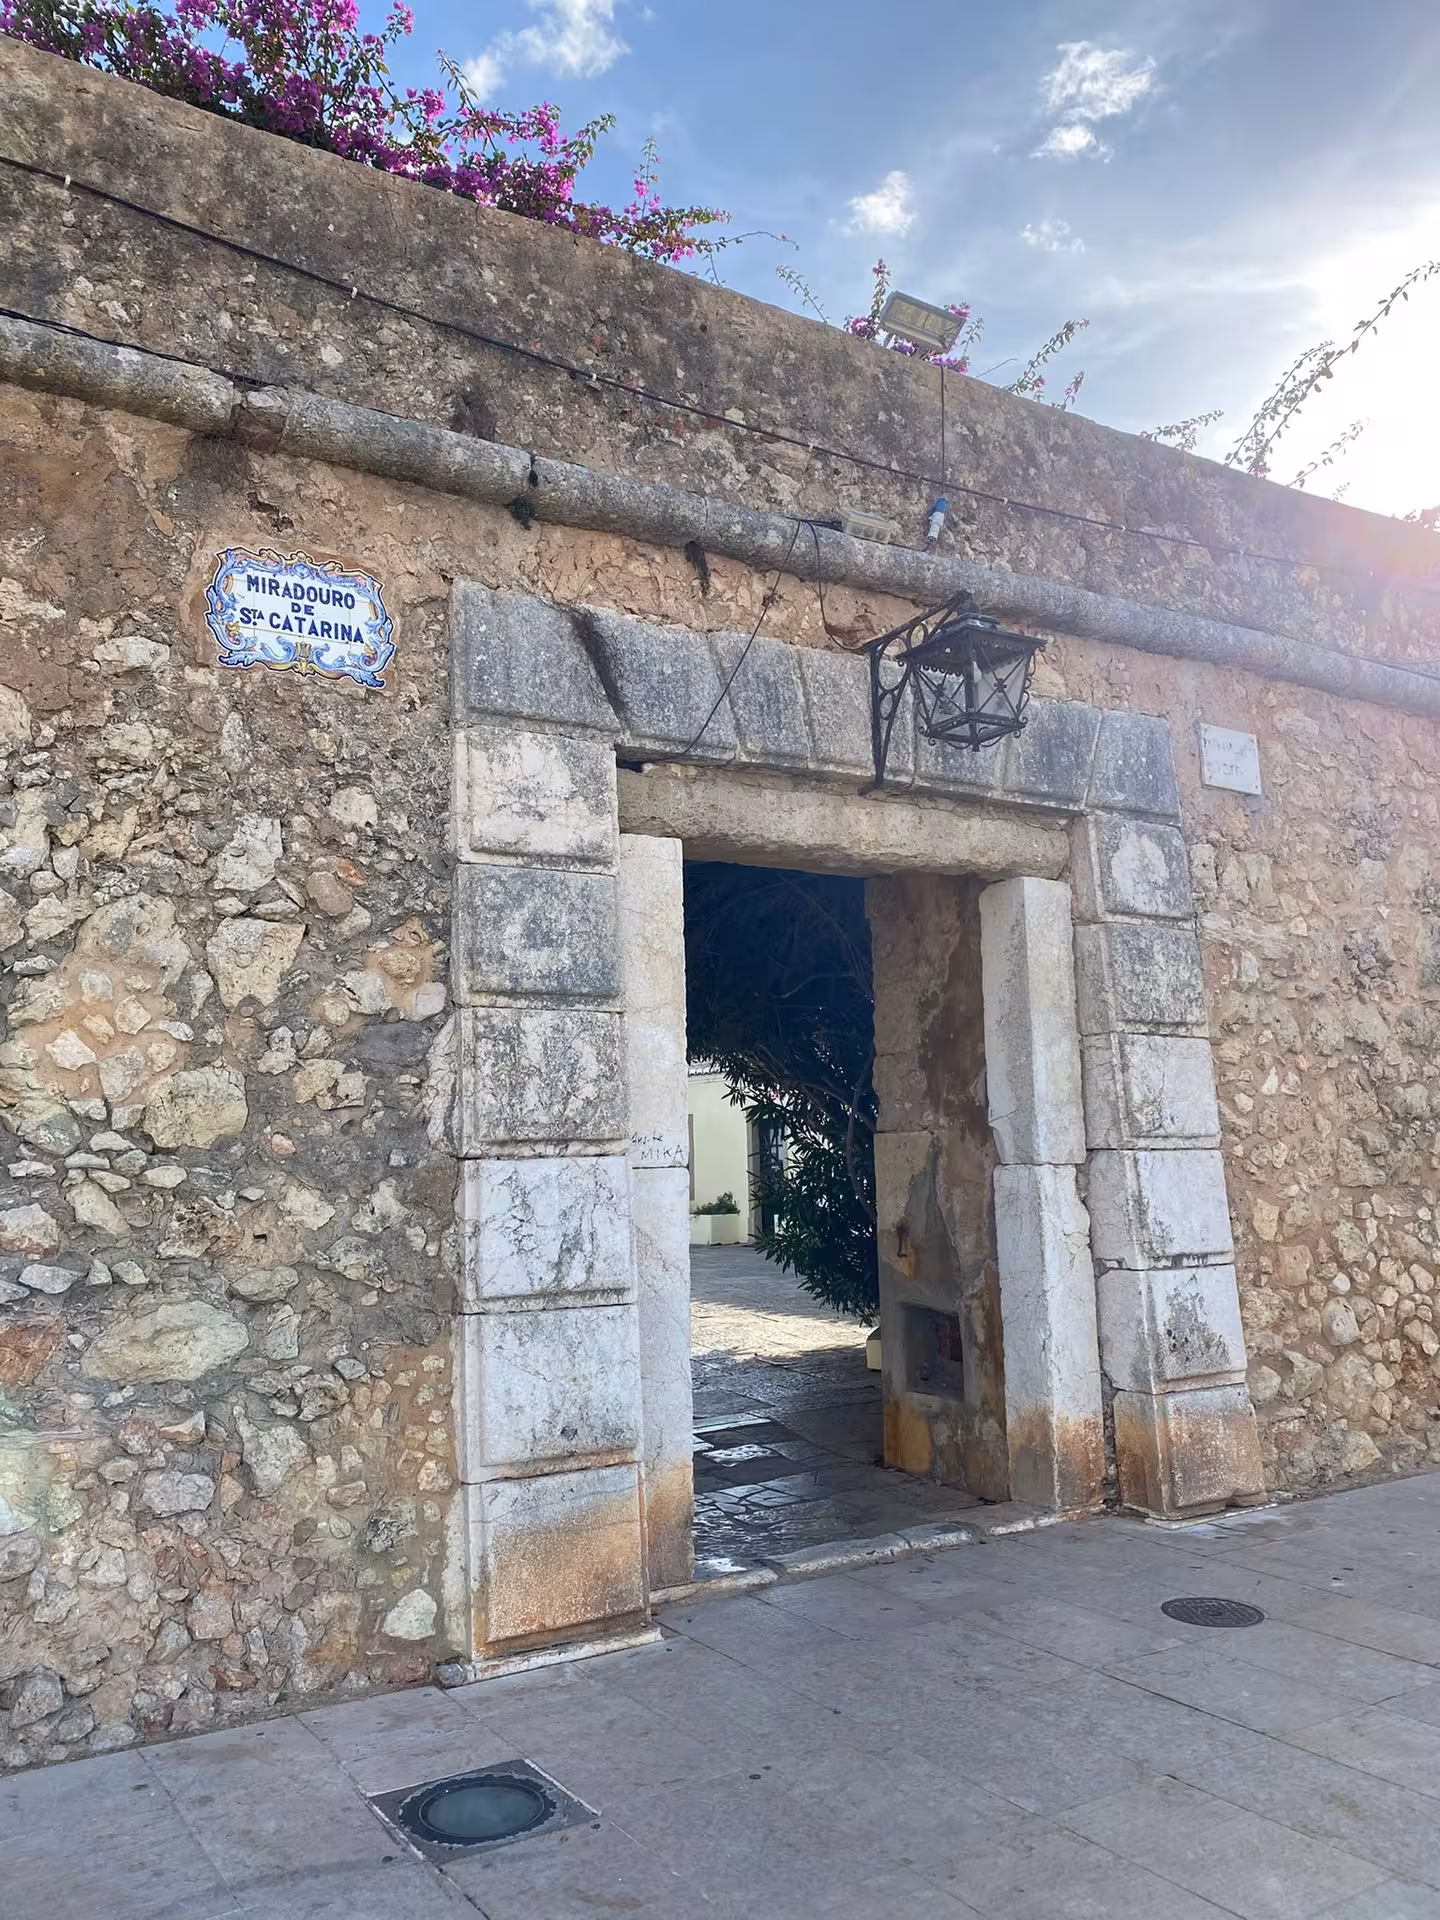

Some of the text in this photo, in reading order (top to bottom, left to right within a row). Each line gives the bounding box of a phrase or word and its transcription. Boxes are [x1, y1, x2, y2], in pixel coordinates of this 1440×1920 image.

[246, 574, 356, 610] MIRADOURO
[291, 602, 315, 616] DE
[269, 612, 364, 644] CATARINA
[641, 1144, 684, 1161] MIKA
